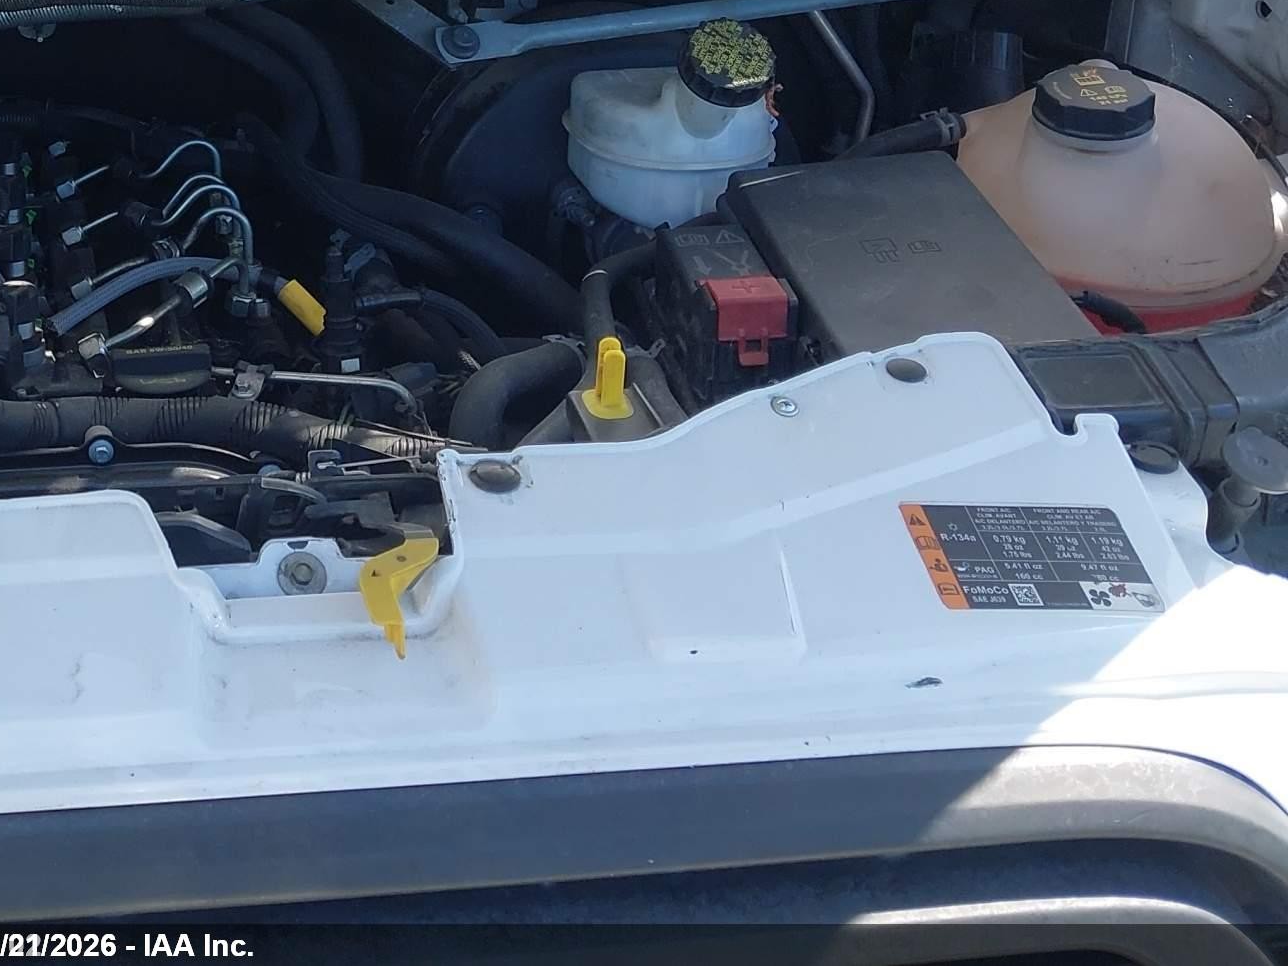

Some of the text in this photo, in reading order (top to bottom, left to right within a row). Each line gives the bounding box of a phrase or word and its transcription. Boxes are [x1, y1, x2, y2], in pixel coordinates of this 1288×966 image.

[940, 533, 977, 542] R-134a
[992, 534, 1026, 545] 0.79 kg
[1065, 536, 1079, 546] kg
[1091, 537, 1124, 547] 1.19 kg
[1117, 553, 1130, 561] lbs
[974, 566, 995, 574] PAG
[963, 586, 1009, 595] FoMoCo
